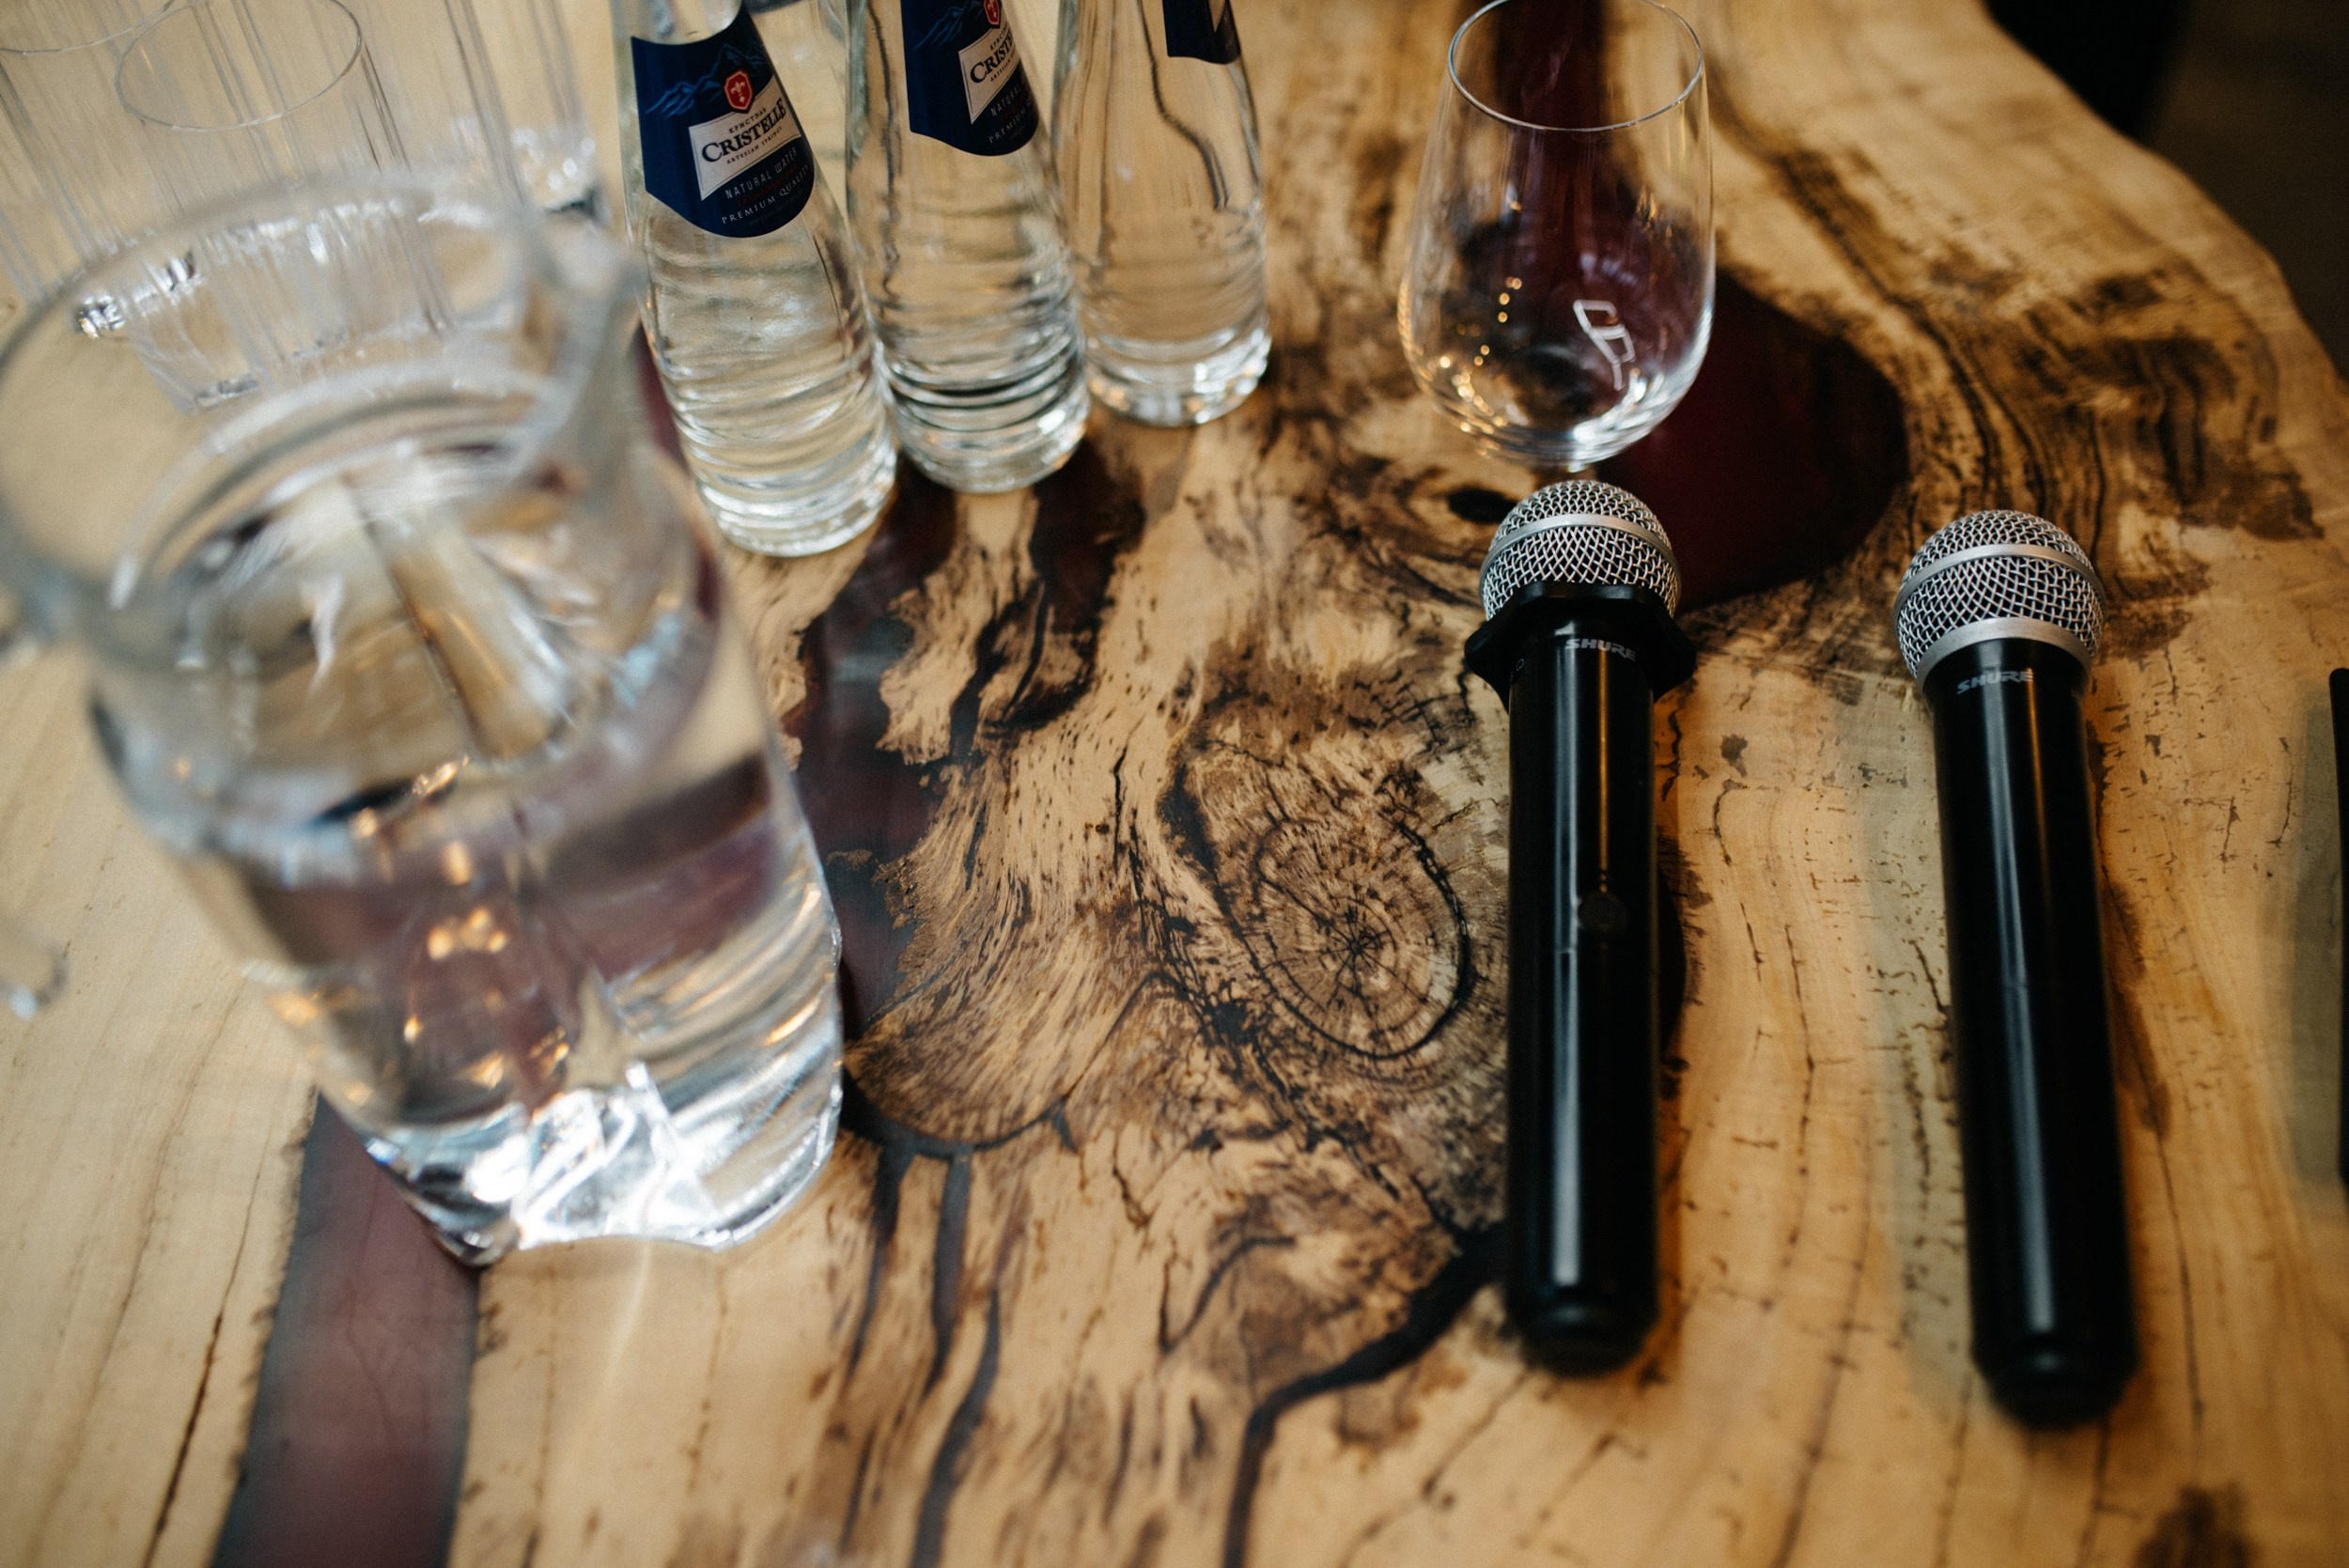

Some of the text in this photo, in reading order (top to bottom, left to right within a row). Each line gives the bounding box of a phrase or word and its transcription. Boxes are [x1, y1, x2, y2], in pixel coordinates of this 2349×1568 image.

[701, 97, 786, 163] CRISTELLE
[724, 171, 772, 199] NATURAL
[774, 147, 798, 174] WATER
[726, 144, 760, 164] ARTESIAN
[722, 195, 776, 225] PREMIUM
[779, 164, 809, 196] QUALITY
[1564, 638, 1637, 661] SHURE
[1956, 671, 2034, 695] SHURE
